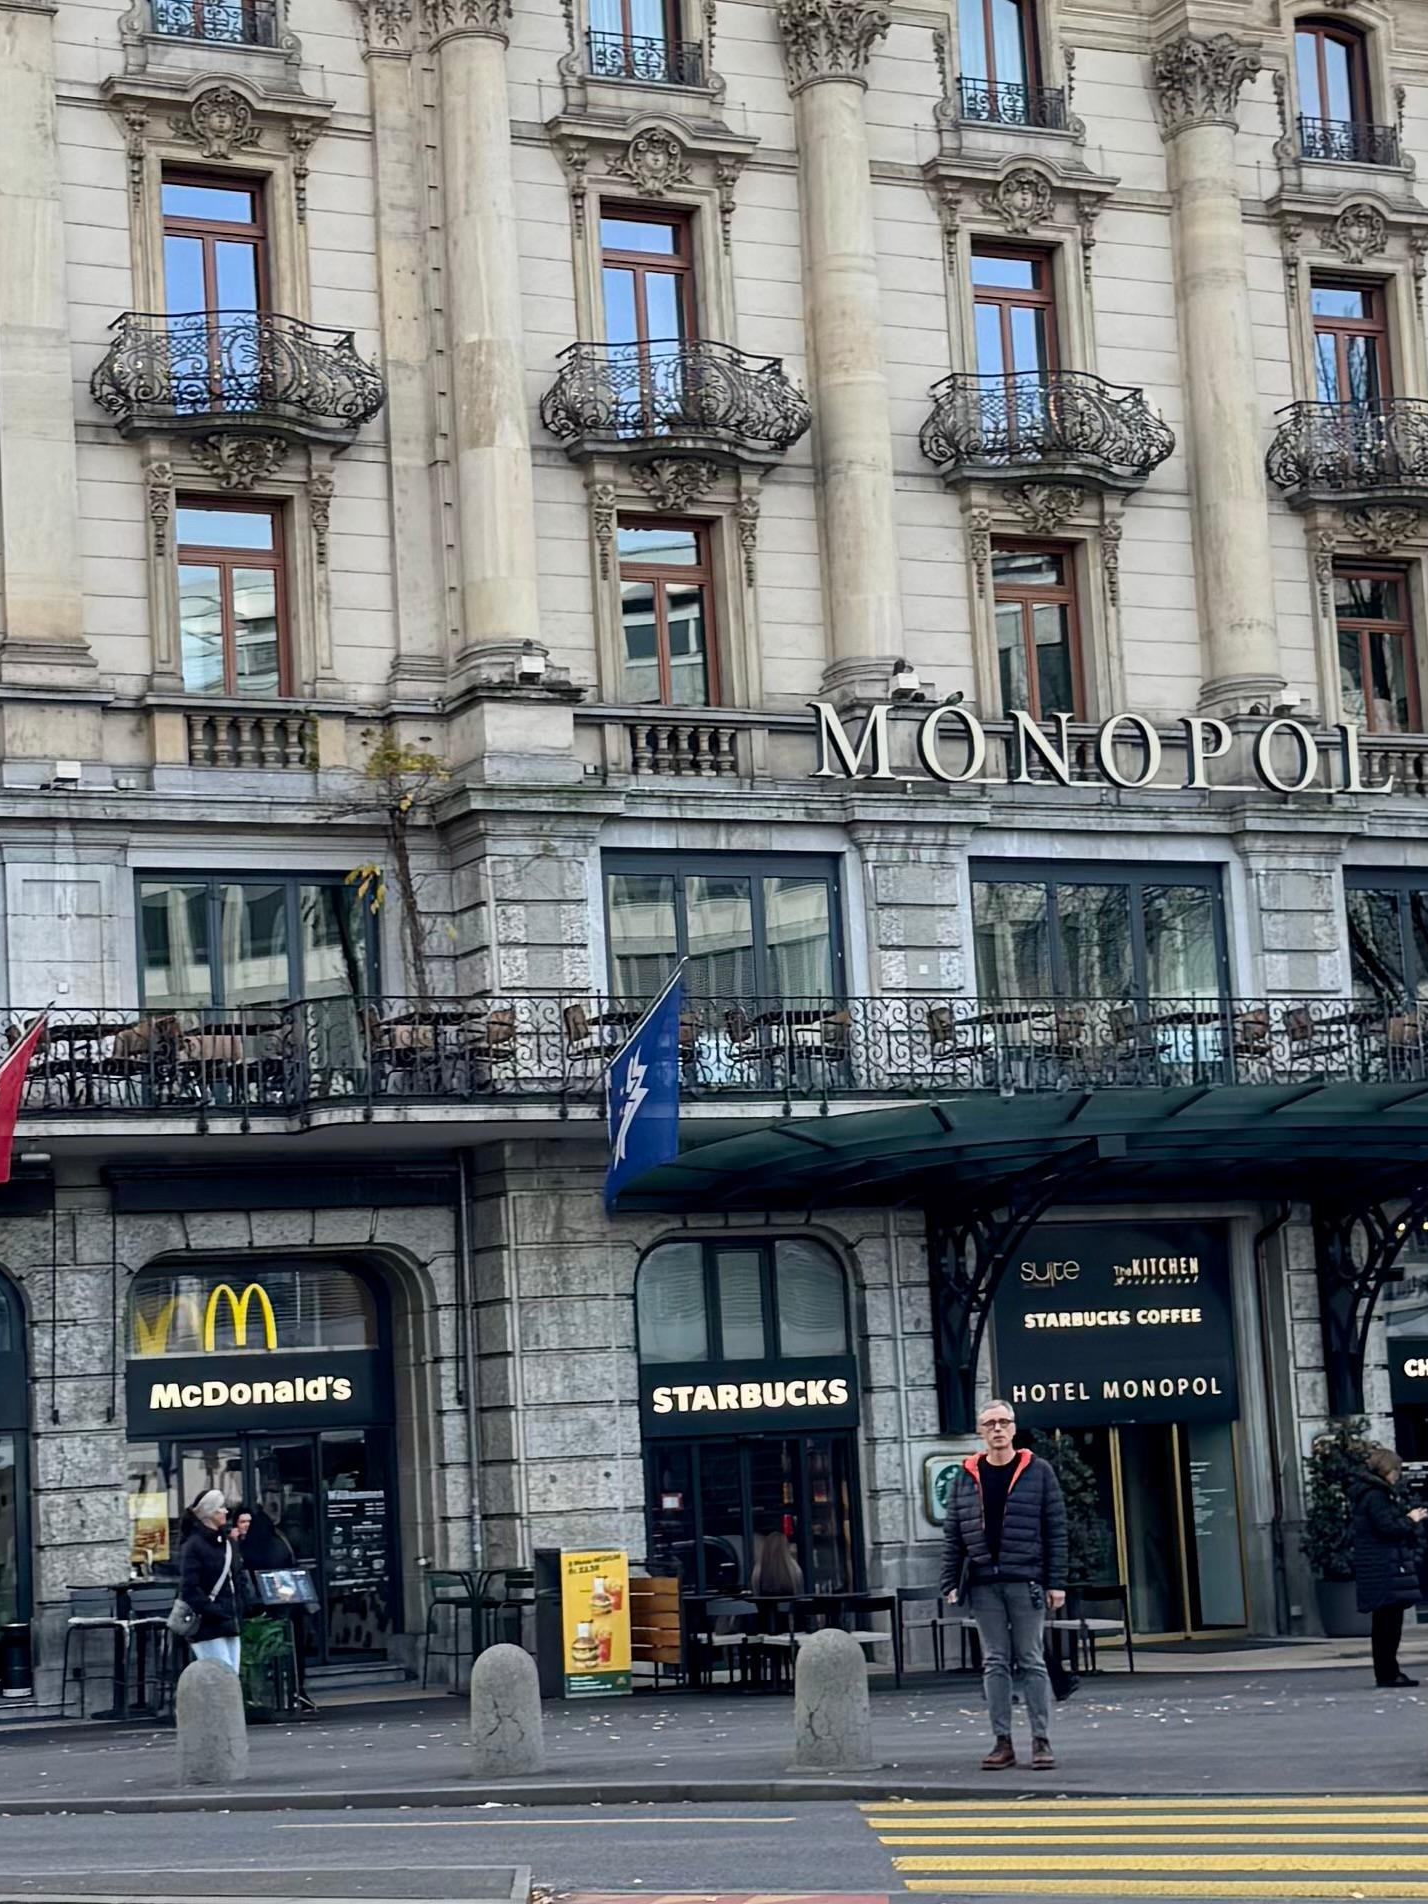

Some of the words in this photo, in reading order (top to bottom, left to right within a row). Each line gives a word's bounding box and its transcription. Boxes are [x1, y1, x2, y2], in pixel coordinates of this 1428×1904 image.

[806, 702, 1394, 794] MONOPOL
[1132, 1257, 1199, 1277] KITCHEN
[1024, 1310, 1130, 1328] STARBUCKS
[1136, 1308, 1202, 1325] COFFEE
[149, 1376, 352, 1409] McDonald's
[653, 1379, 848, 1413] STARBUCKS
[1013, 1383, 1090, 1403] HOTEL
[1103, 1378, 1222, 1399] MONOPOL
